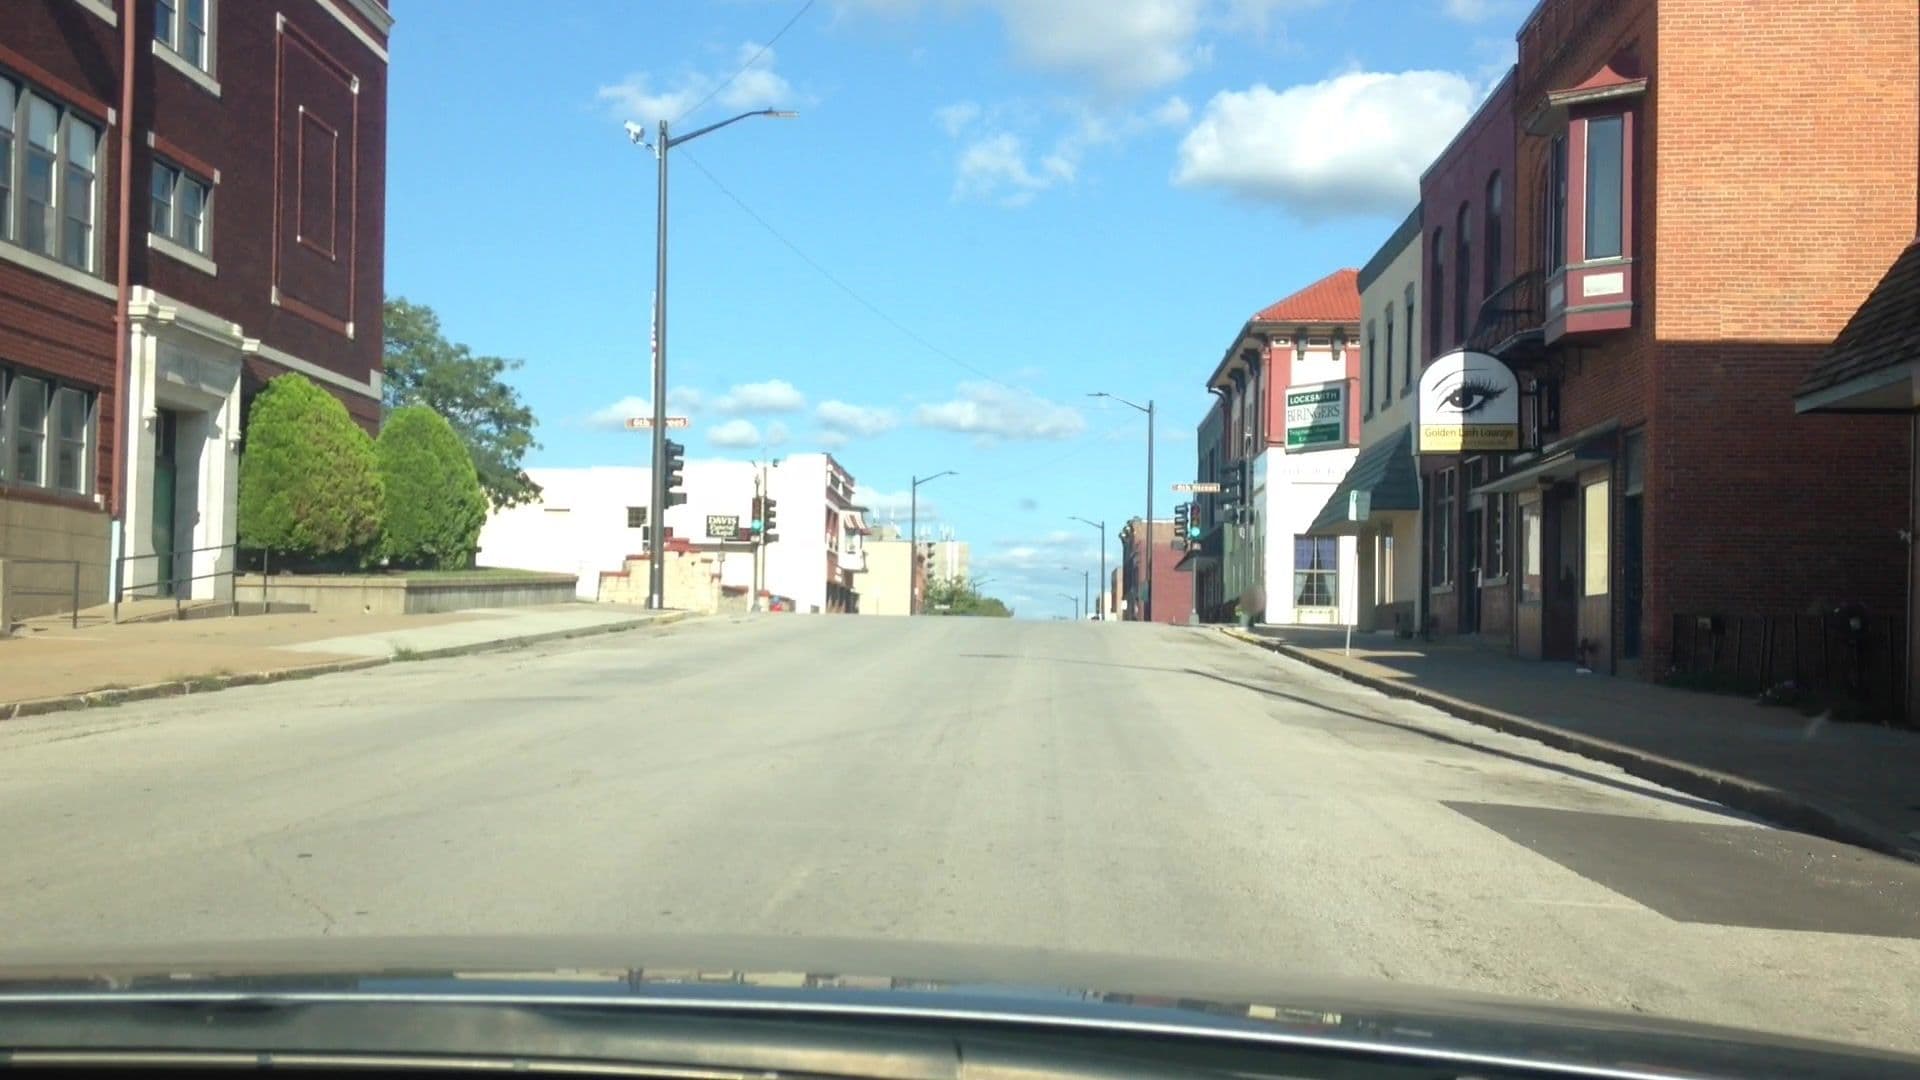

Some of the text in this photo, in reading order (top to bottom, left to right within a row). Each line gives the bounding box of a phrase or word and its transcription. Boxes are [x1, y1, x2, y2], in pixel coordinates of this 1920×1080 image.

[1289, 392, 1337, 405] LOCKSMITH
[1424, 427, 1457, 438] Golden
[708, 516, 737, 525] DAVIS
